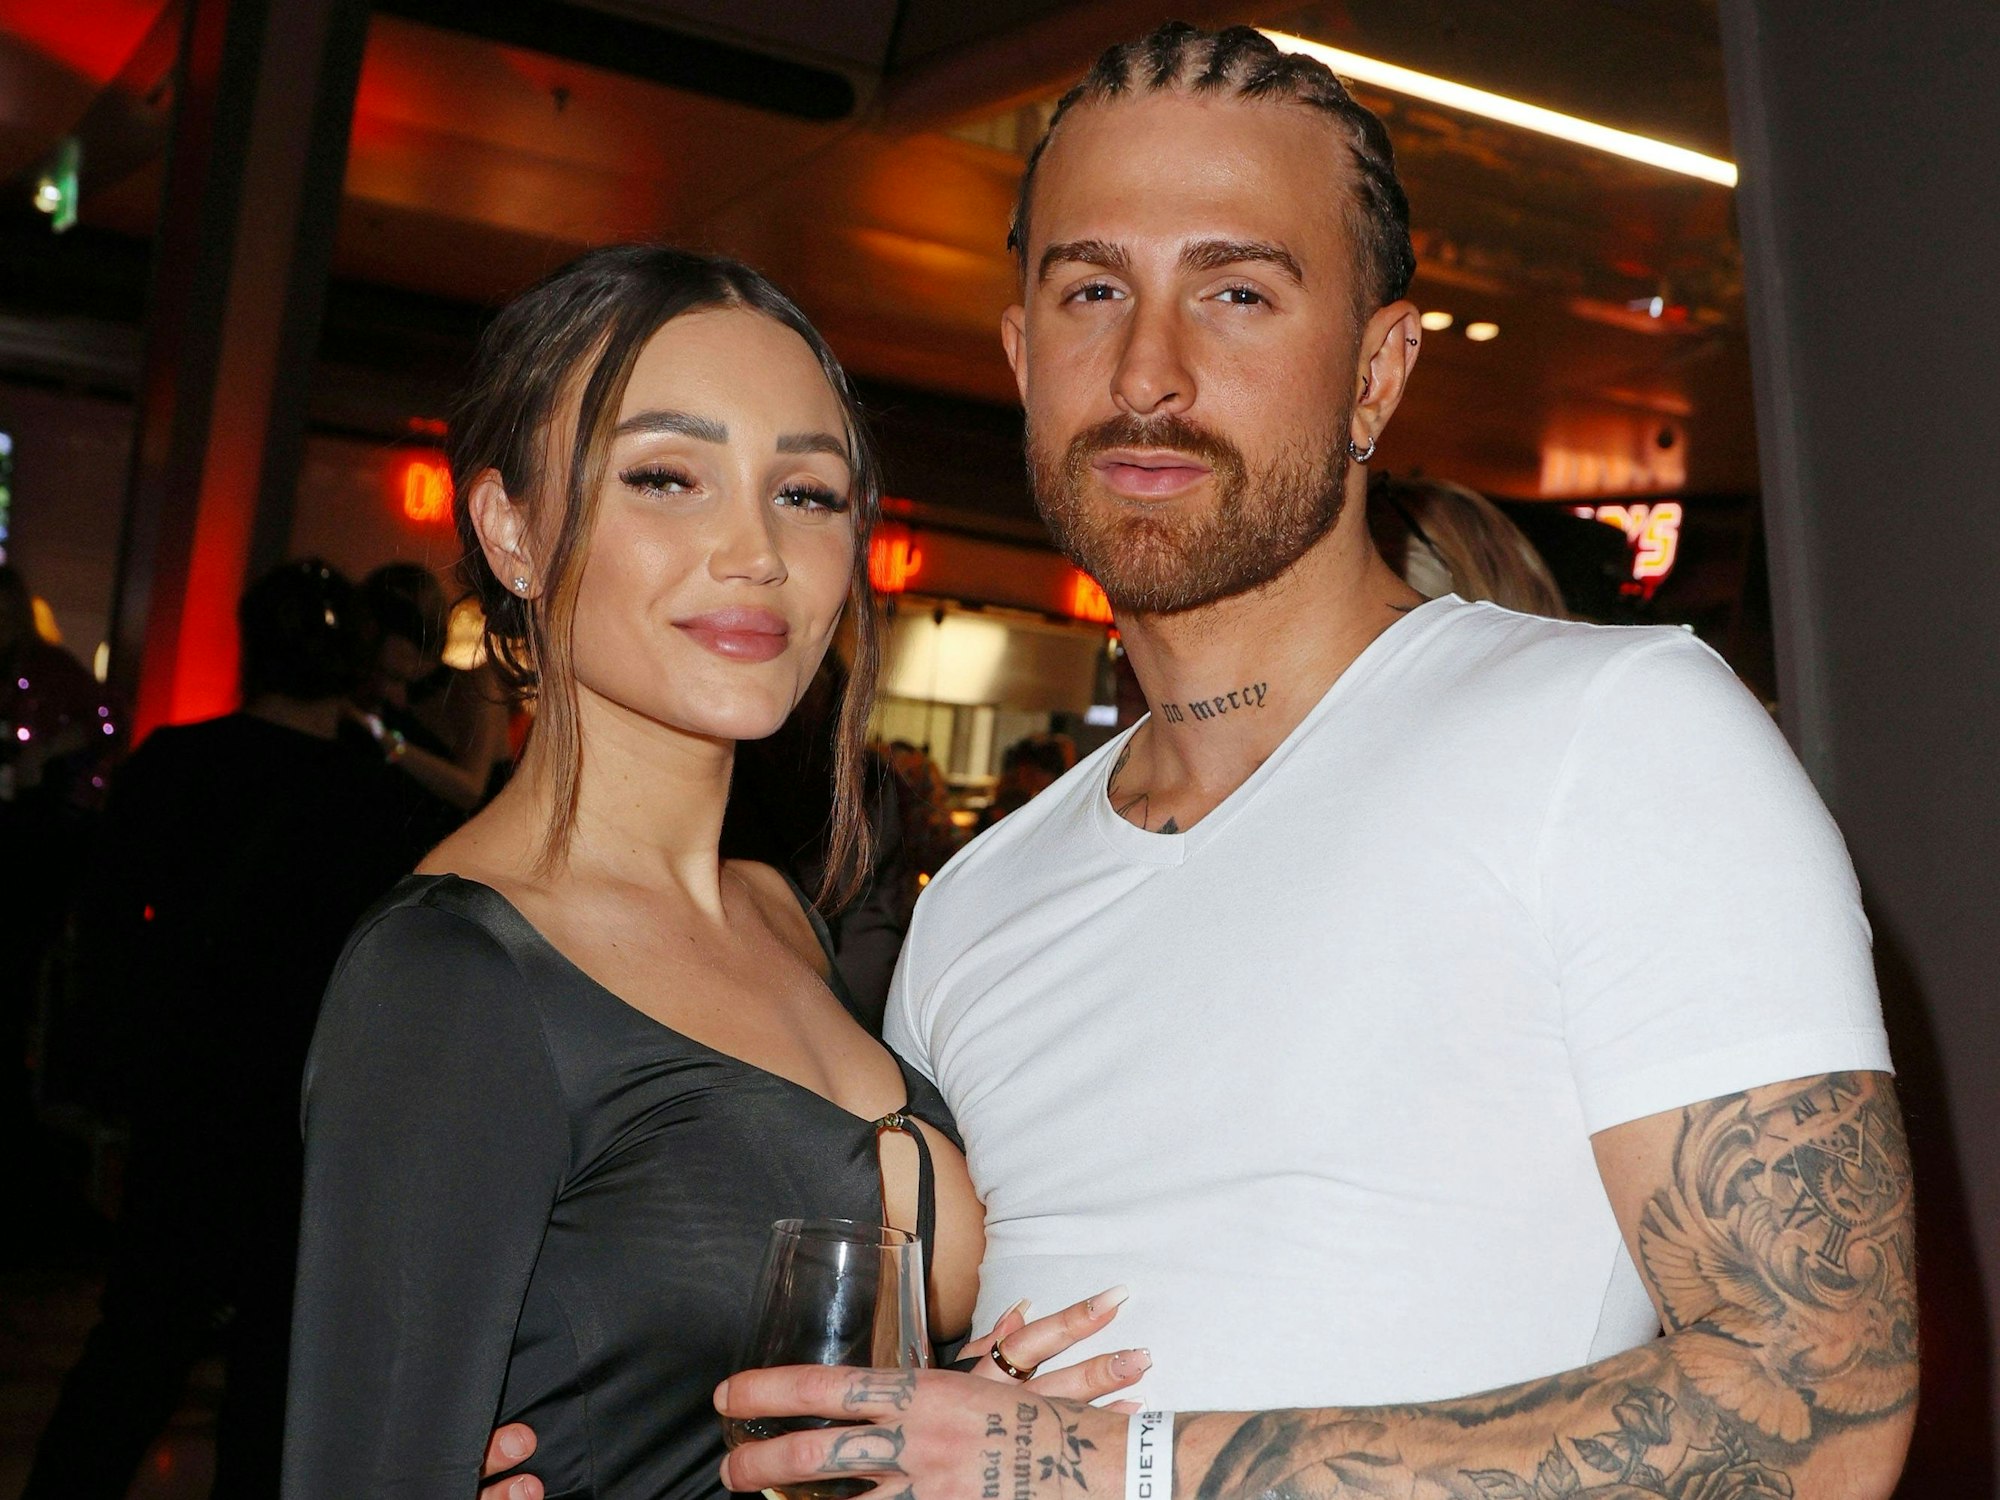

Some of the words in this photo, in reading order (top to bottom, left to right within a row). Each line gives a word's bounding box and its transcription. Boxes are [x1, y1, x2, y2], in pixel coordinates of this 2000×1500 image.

[1161, 702, 1185, 724] no
[1188, 682, 1268, 722] mercy
[1139, 1424, 1154, 1499] CIETY
